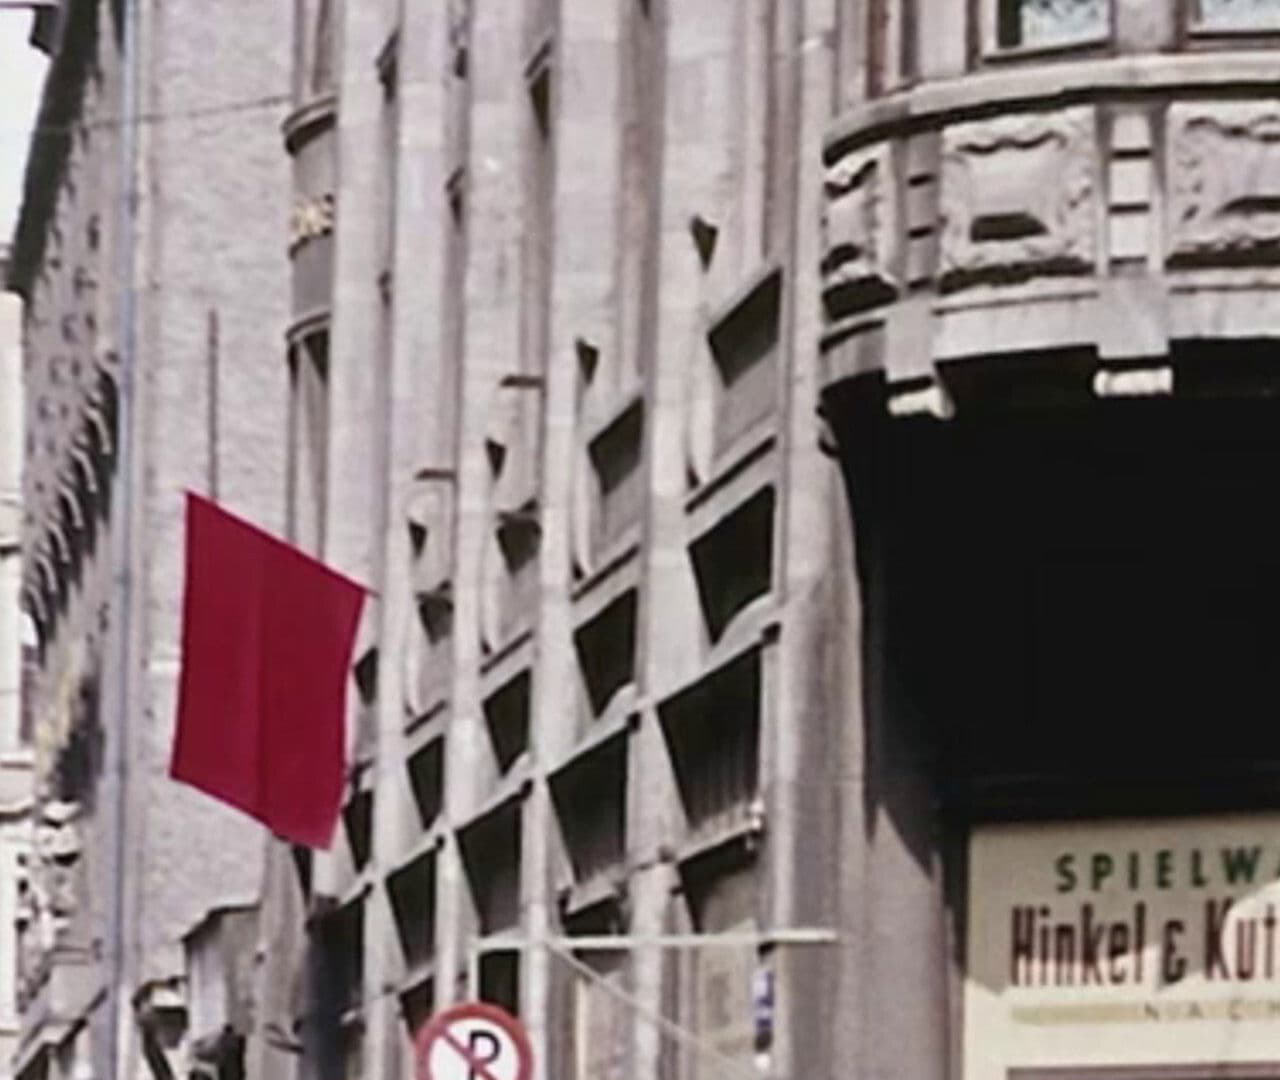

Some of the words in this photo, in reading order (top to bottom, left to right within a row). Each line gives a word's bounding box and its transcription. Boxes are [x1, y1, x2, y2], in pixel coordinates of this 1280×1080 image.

[1054, 846, 1280, 894] SPIELW
[1011, 901, 1146, 986] Hinkel
[1161, 918, 1187, 984] &
